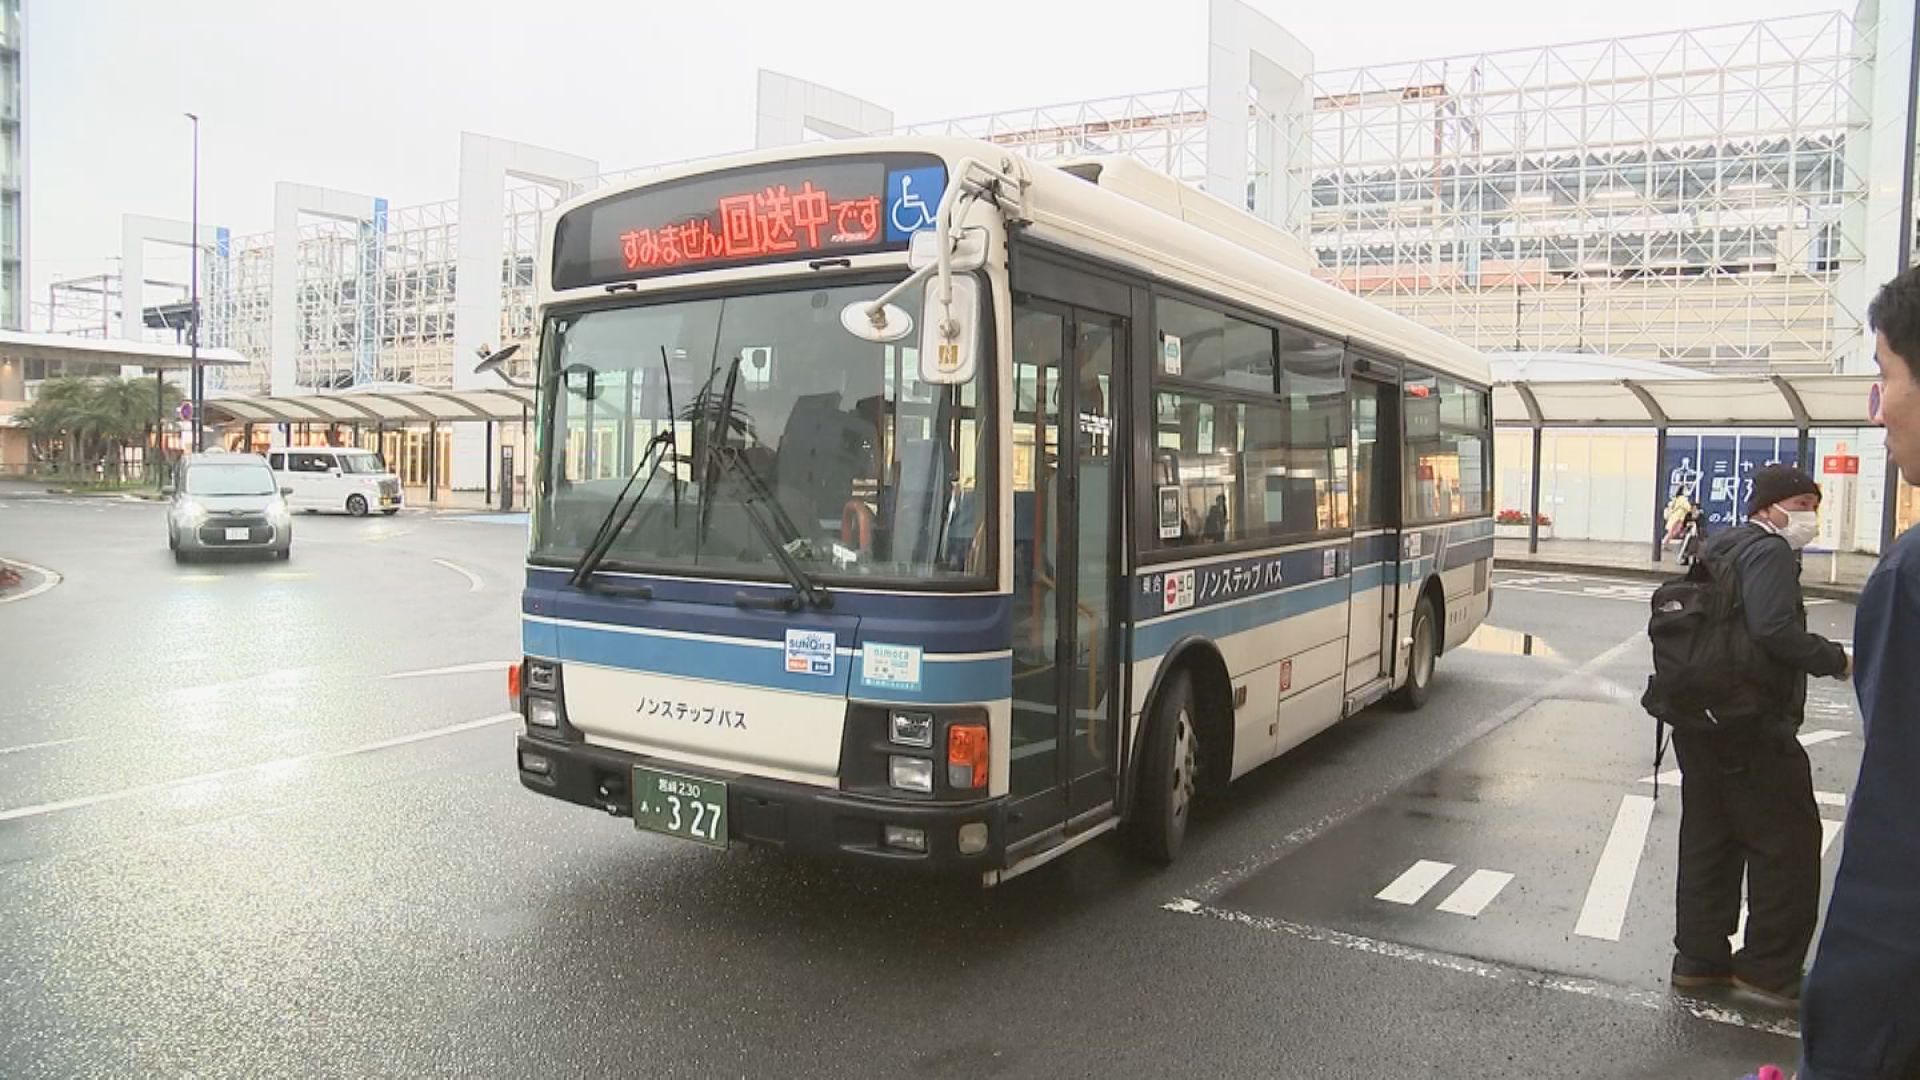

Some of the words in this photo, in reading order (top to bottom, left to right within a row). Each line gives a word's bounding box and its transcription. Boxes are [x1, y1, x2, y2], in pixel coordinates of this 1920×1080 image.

[620, 181, 881, 269] すみません回送中です
[636, 697, 747, 730] ノンステップバス
